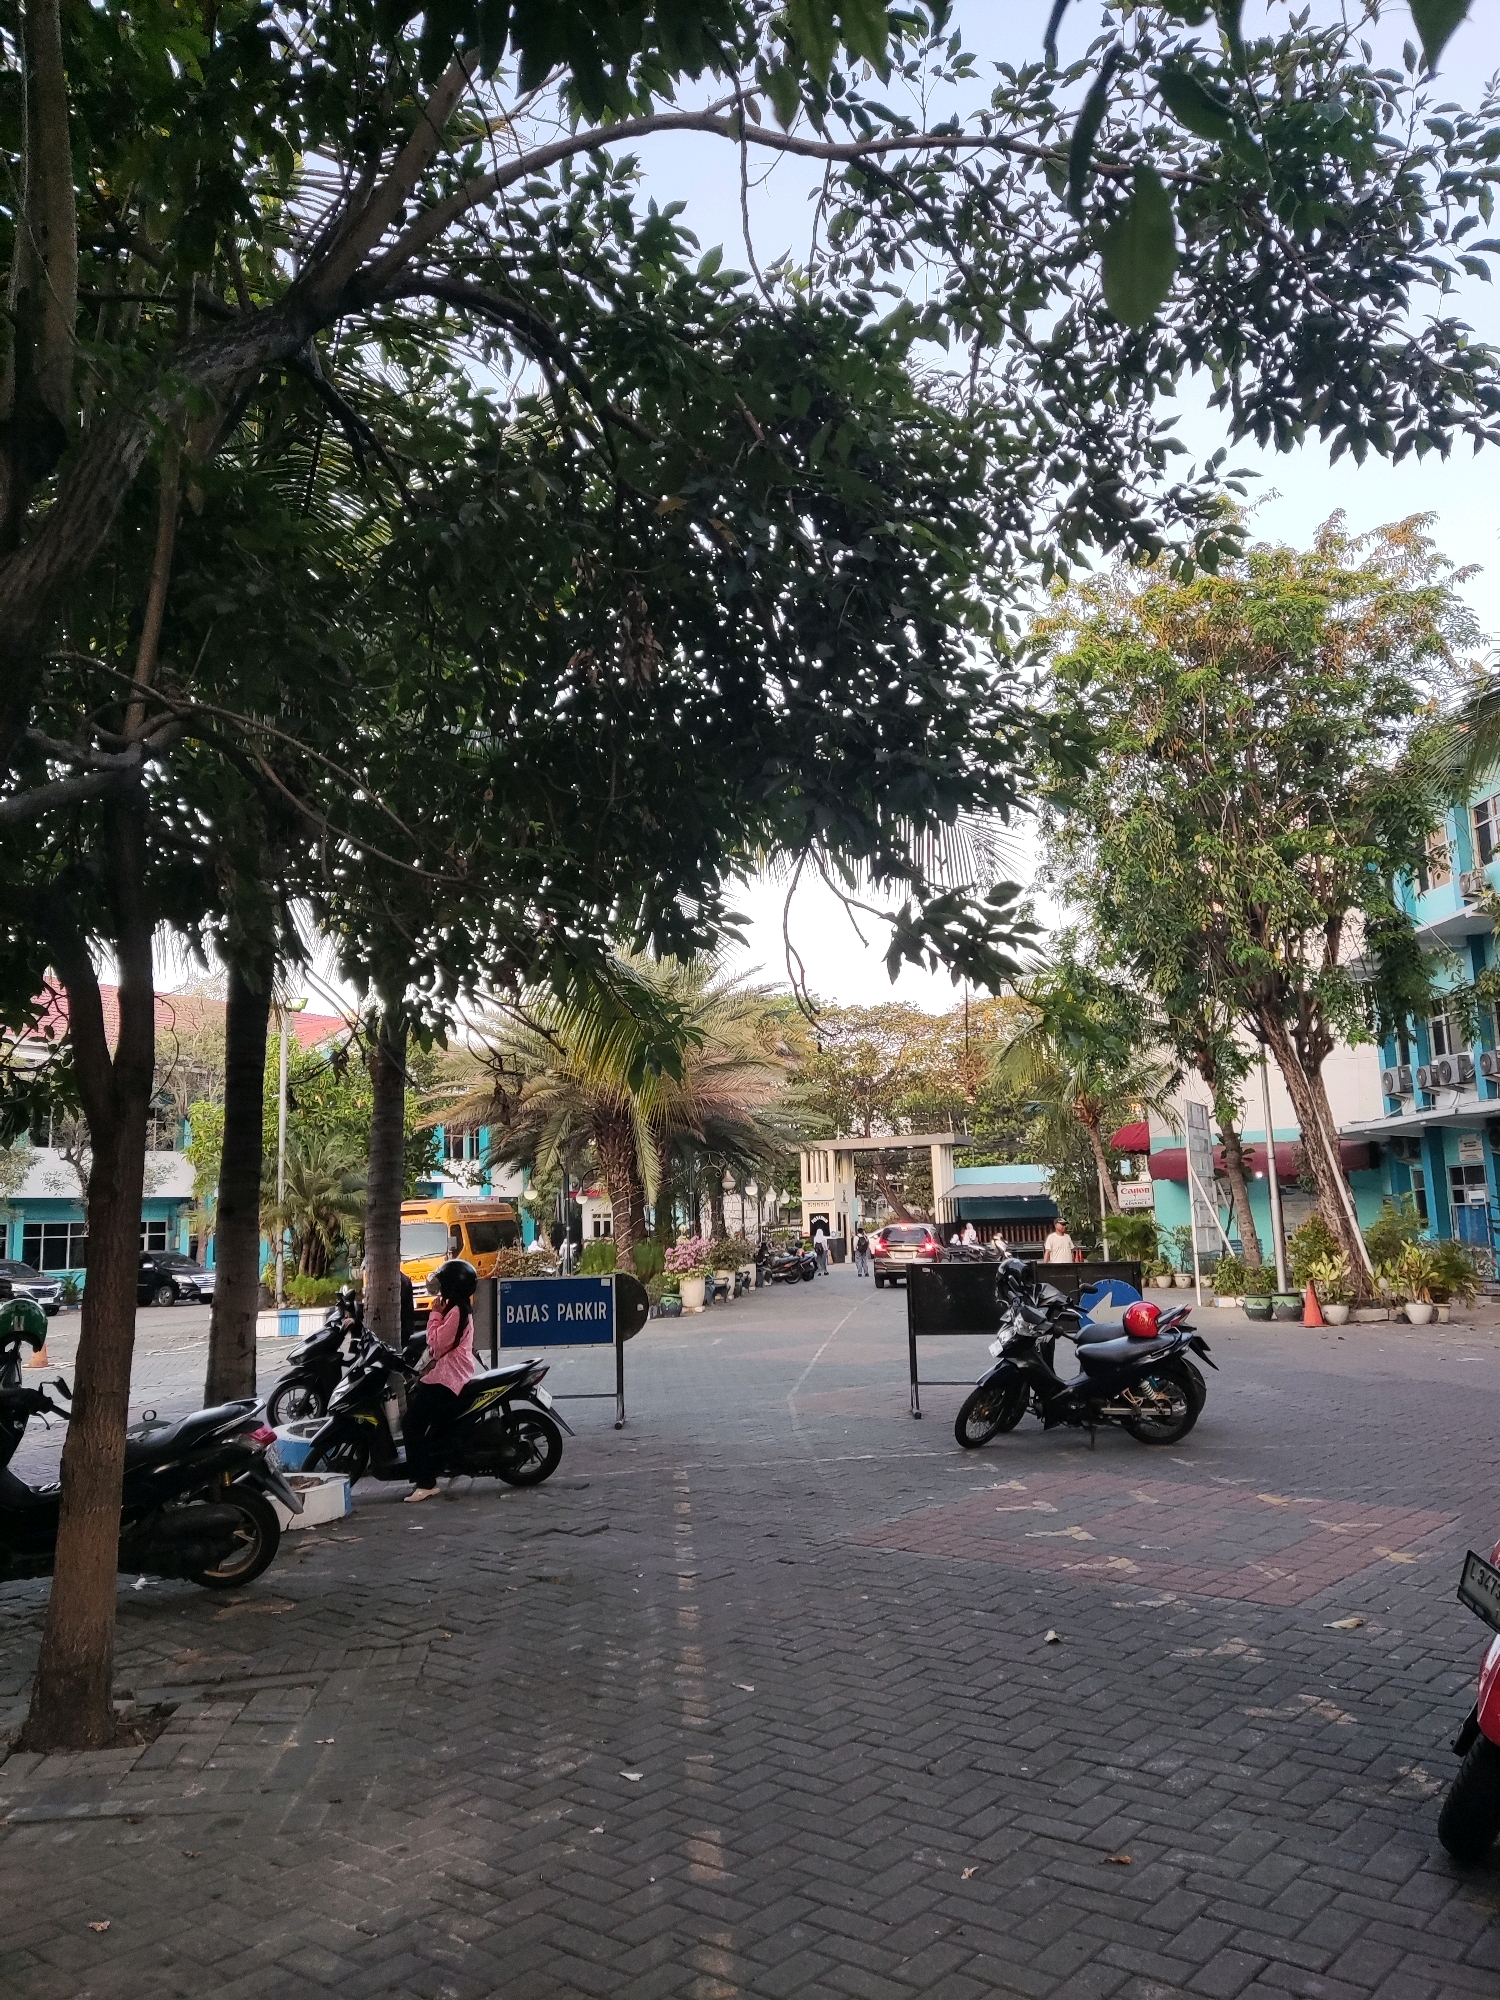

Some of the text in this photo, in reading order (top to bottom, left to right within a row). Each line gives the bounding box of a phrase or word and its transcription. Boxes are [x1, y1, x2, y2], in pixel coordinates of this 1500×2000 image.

[1120, 1187, 1150, 1195] Canon
[506, 1301, 607, 1324] BATAS PARKIR
